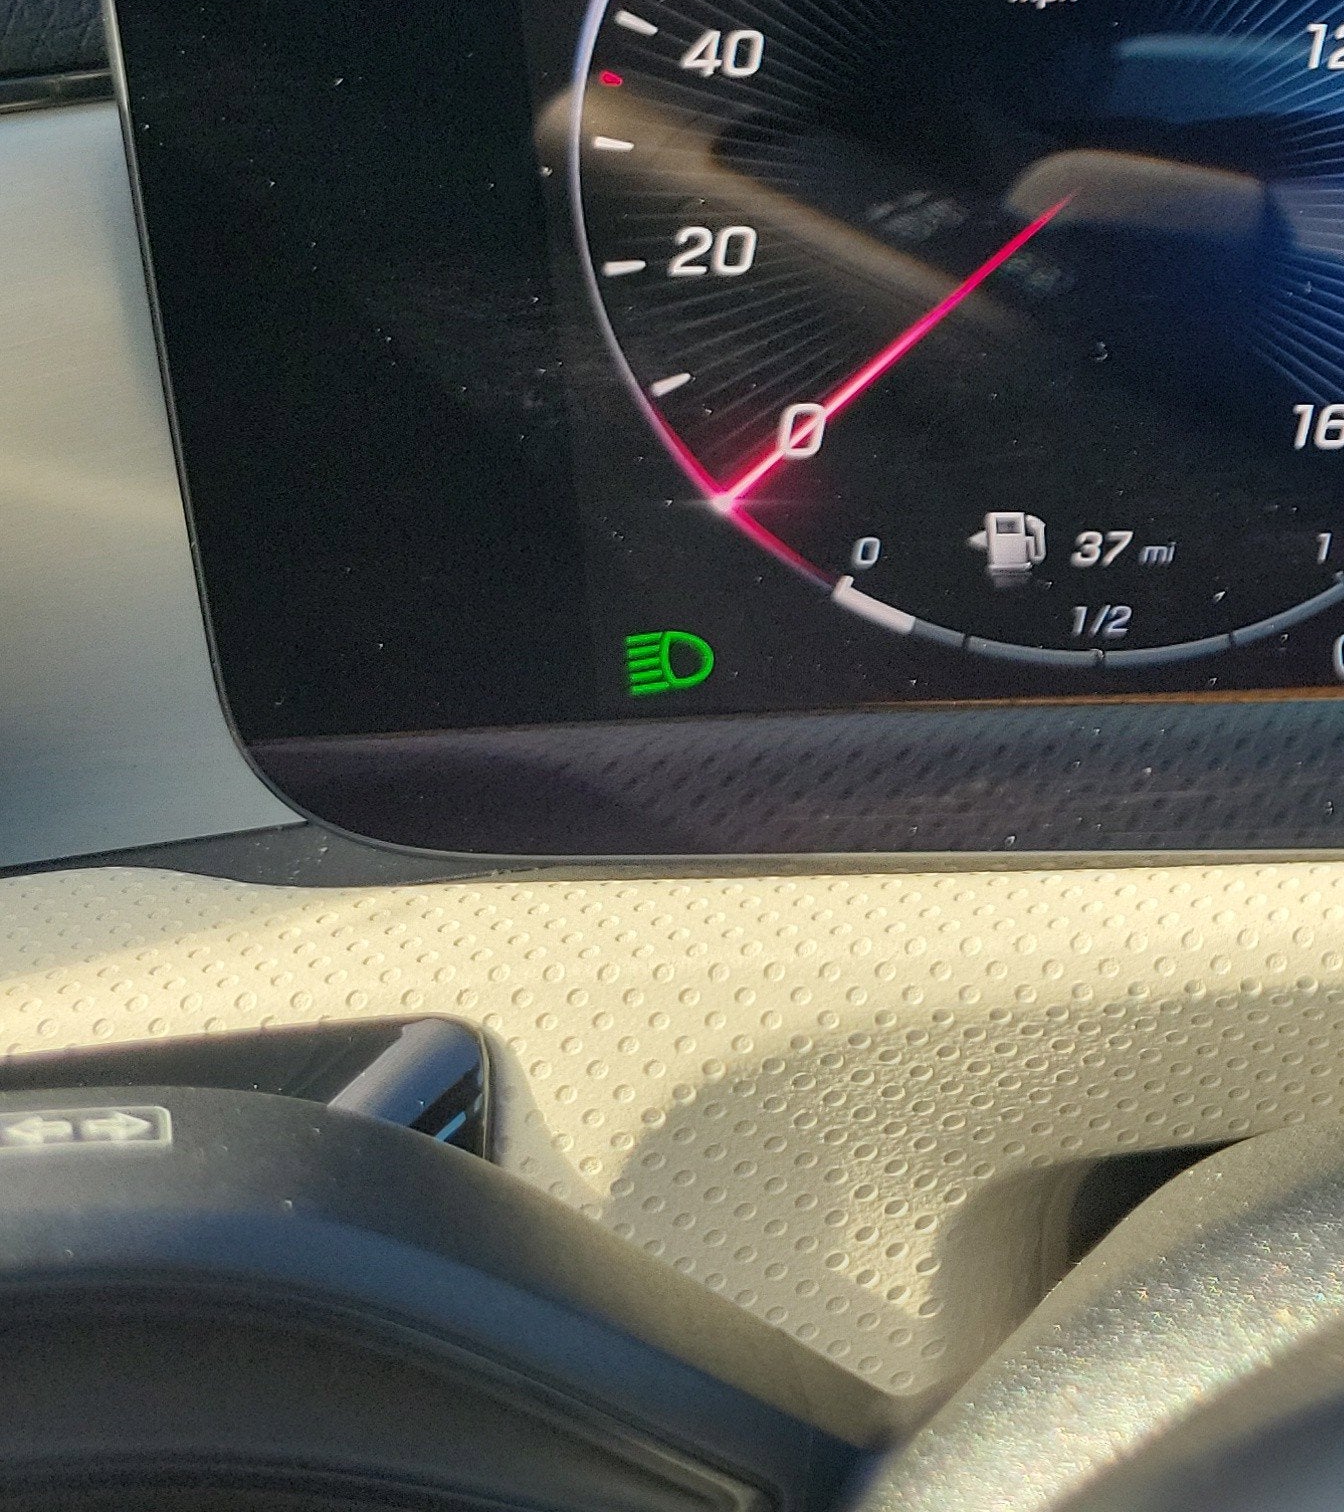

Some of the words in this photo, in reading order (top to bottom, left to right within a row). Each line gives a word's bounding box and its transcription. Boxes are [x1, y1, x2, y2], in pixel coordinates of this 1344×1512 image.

[680, 29, 764, 78] 40
[668, 225, 757, 276] 20
[779, 402, 826, 458] 0
[852, 536, 881, 569] 0
[1071, 530, 1134, 567] 37
[1139, 545, 1175, 563] mi
[1318, 532, 1332, 562] 1
[1073, 604, 1132, 636] 1/2
